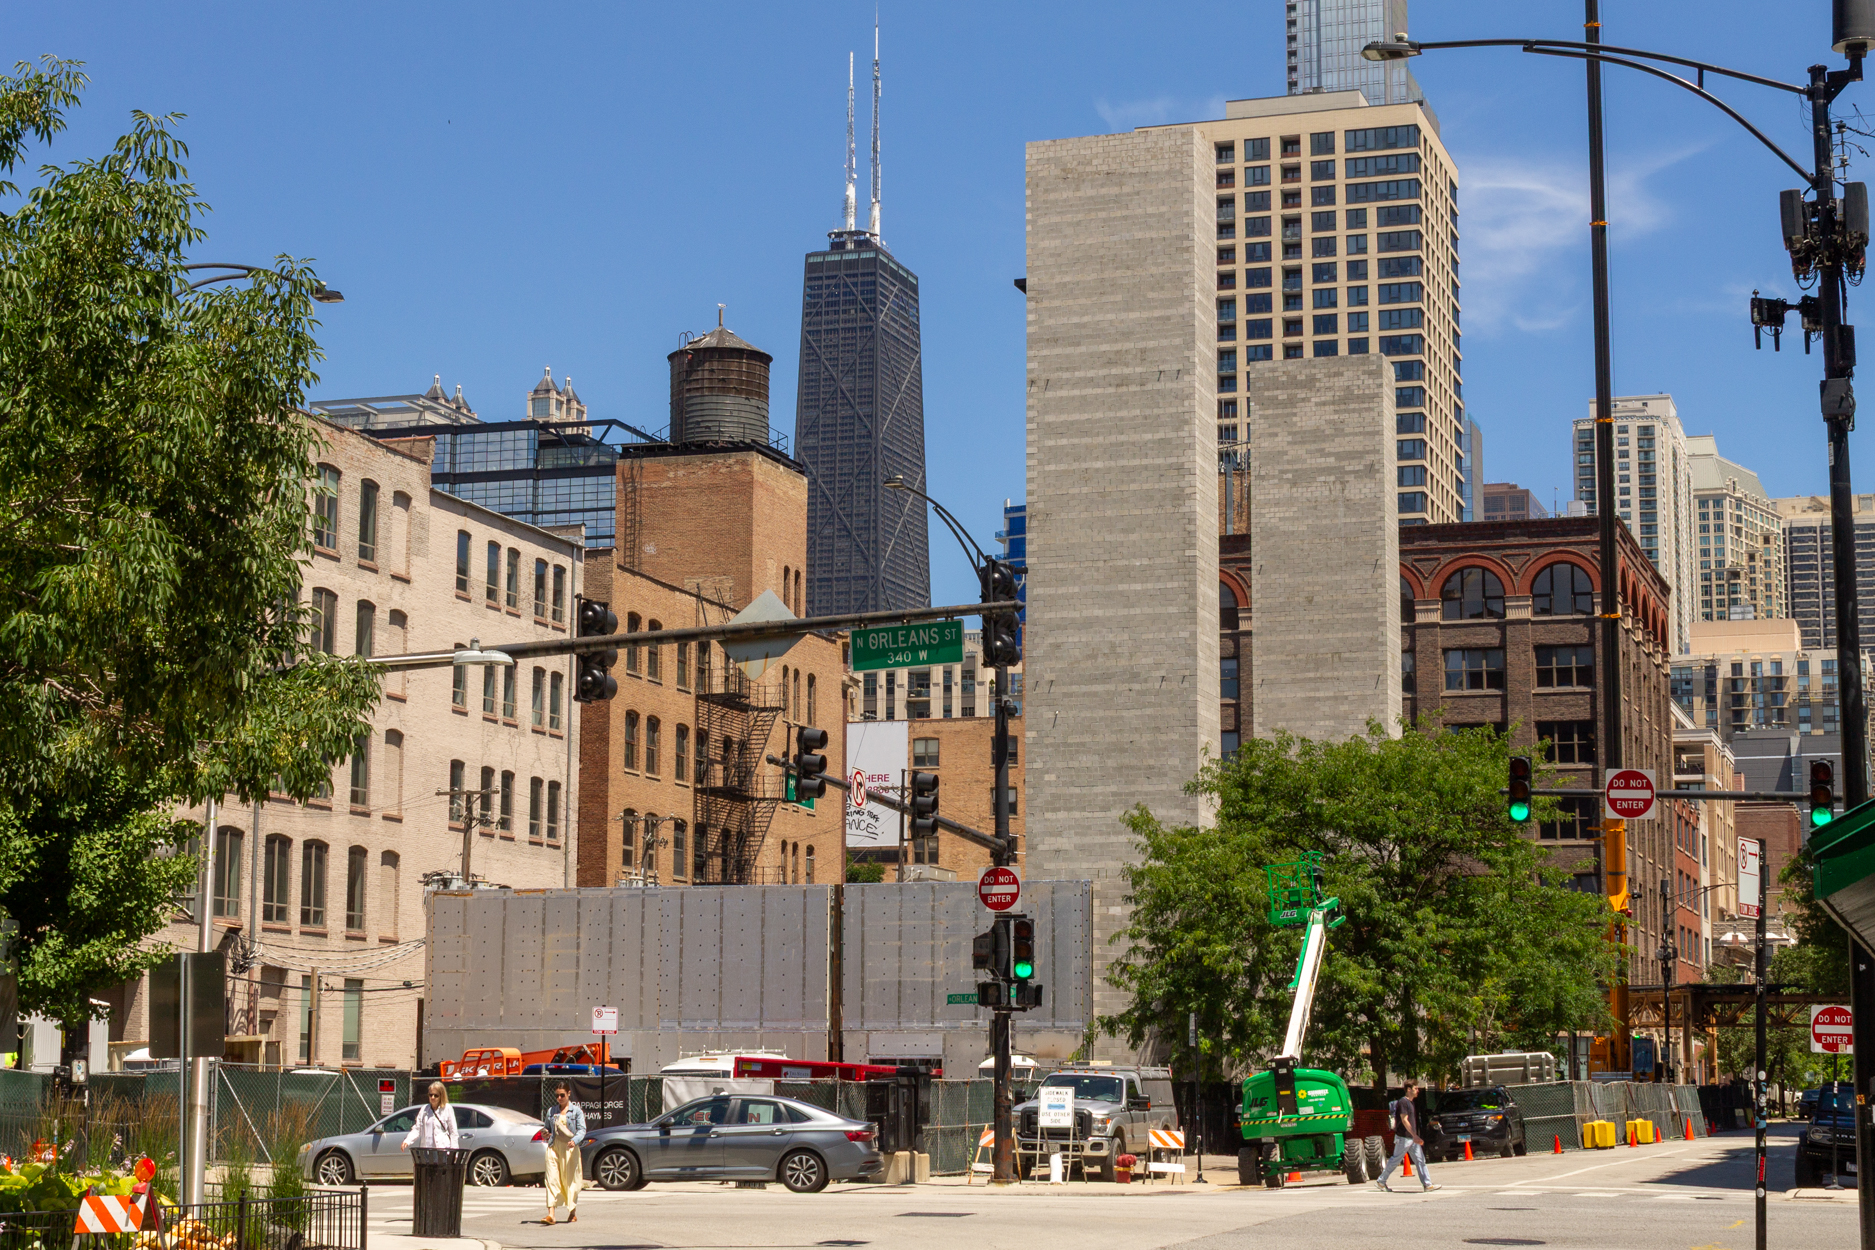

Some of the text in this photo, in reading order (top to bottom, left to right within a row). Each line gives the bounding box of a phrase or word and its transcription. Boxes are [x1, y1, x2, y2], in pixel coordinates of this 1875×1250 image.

[857, 628, 956, 649] N ORLEANS ST
[888, 650, 928, 664] 340 W
[1616, 801, 1644, 809] ENTER
[988, 895, 1011, 903] ENTER
[1280, 910, 1297, 918] JLG
[1249, 1097, 1268, 1108] JLG
